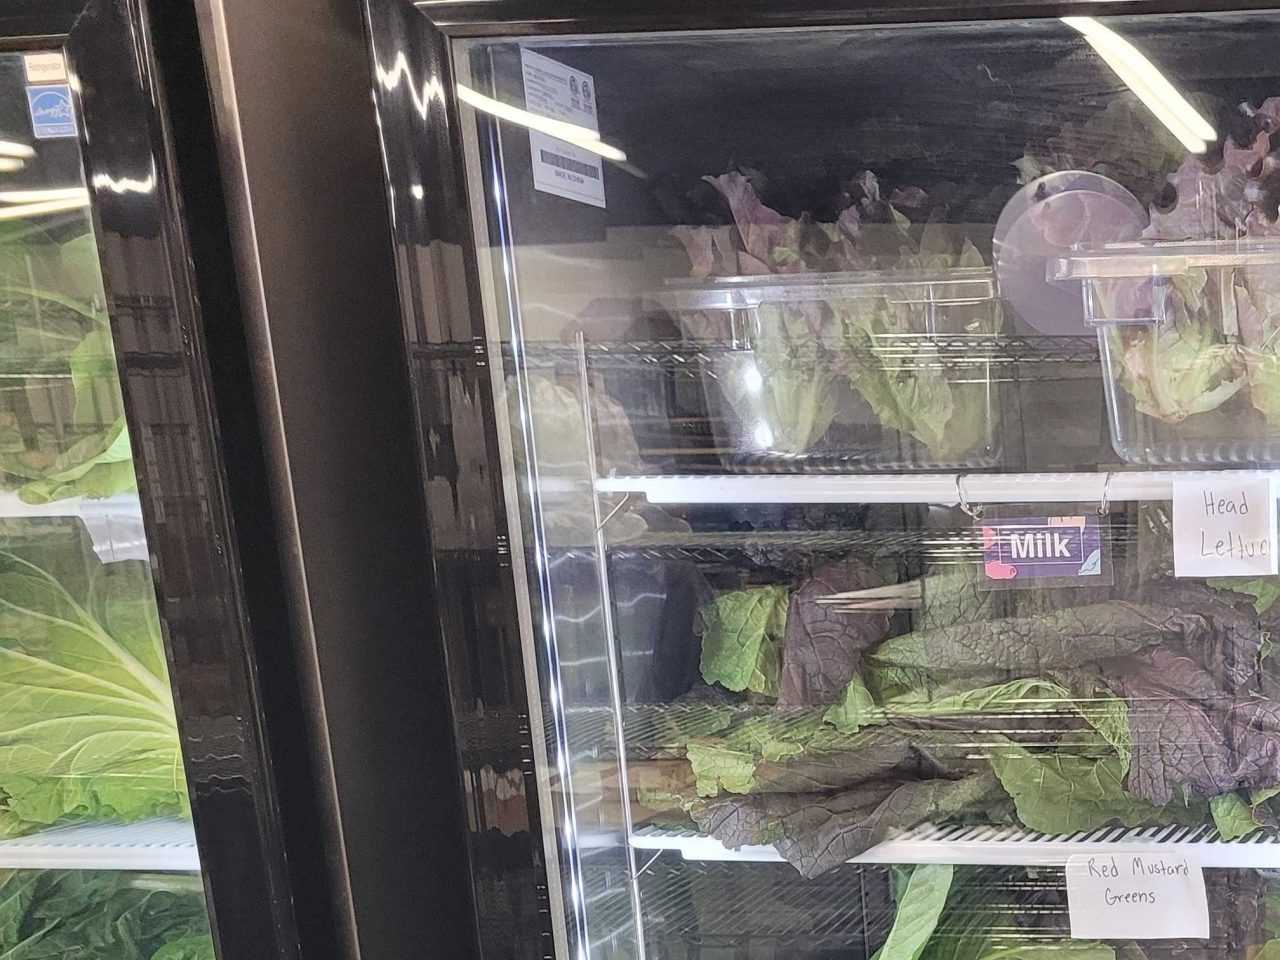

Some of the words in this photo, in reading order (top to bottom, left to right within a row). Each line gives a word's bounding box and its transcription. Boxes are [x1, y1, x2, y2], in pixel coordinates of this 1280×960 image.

[1203, 489, 1249, 517] Head
[1010, 531, 1071, 559] Milk
[1200, 530, 1270, 560] Lettuc
[1088, 856, 1120, 878] Red
[1132, 856, 1190, 876] Mustard
[1104, 887, 1156, 906] Greens
